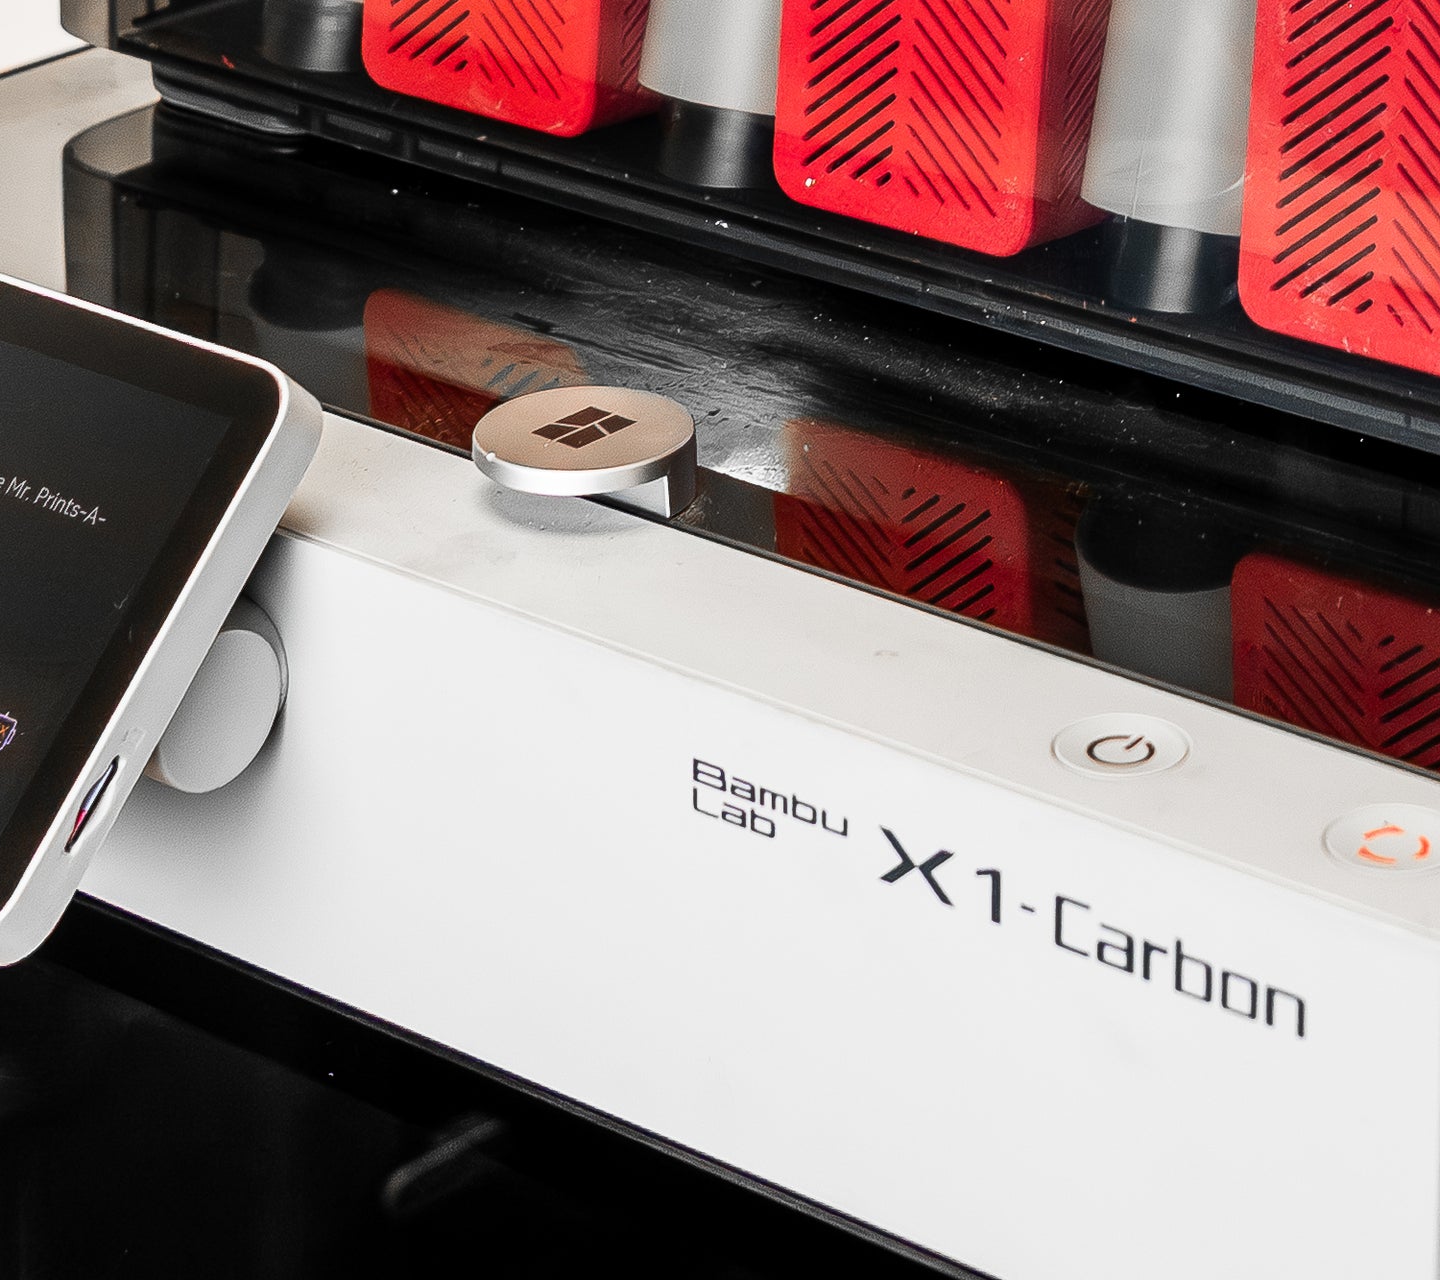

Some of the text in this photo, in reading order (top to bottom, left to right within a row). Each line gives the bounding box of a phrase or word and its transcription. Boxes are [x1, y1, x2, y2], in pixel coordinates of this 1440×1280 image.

[5, 476, 32, 501] Mr.
[33, 487, 107, 525] Prints-A-
[693, 758, 848, 836] Bambu
[693, 787, 775, 838] Lab
